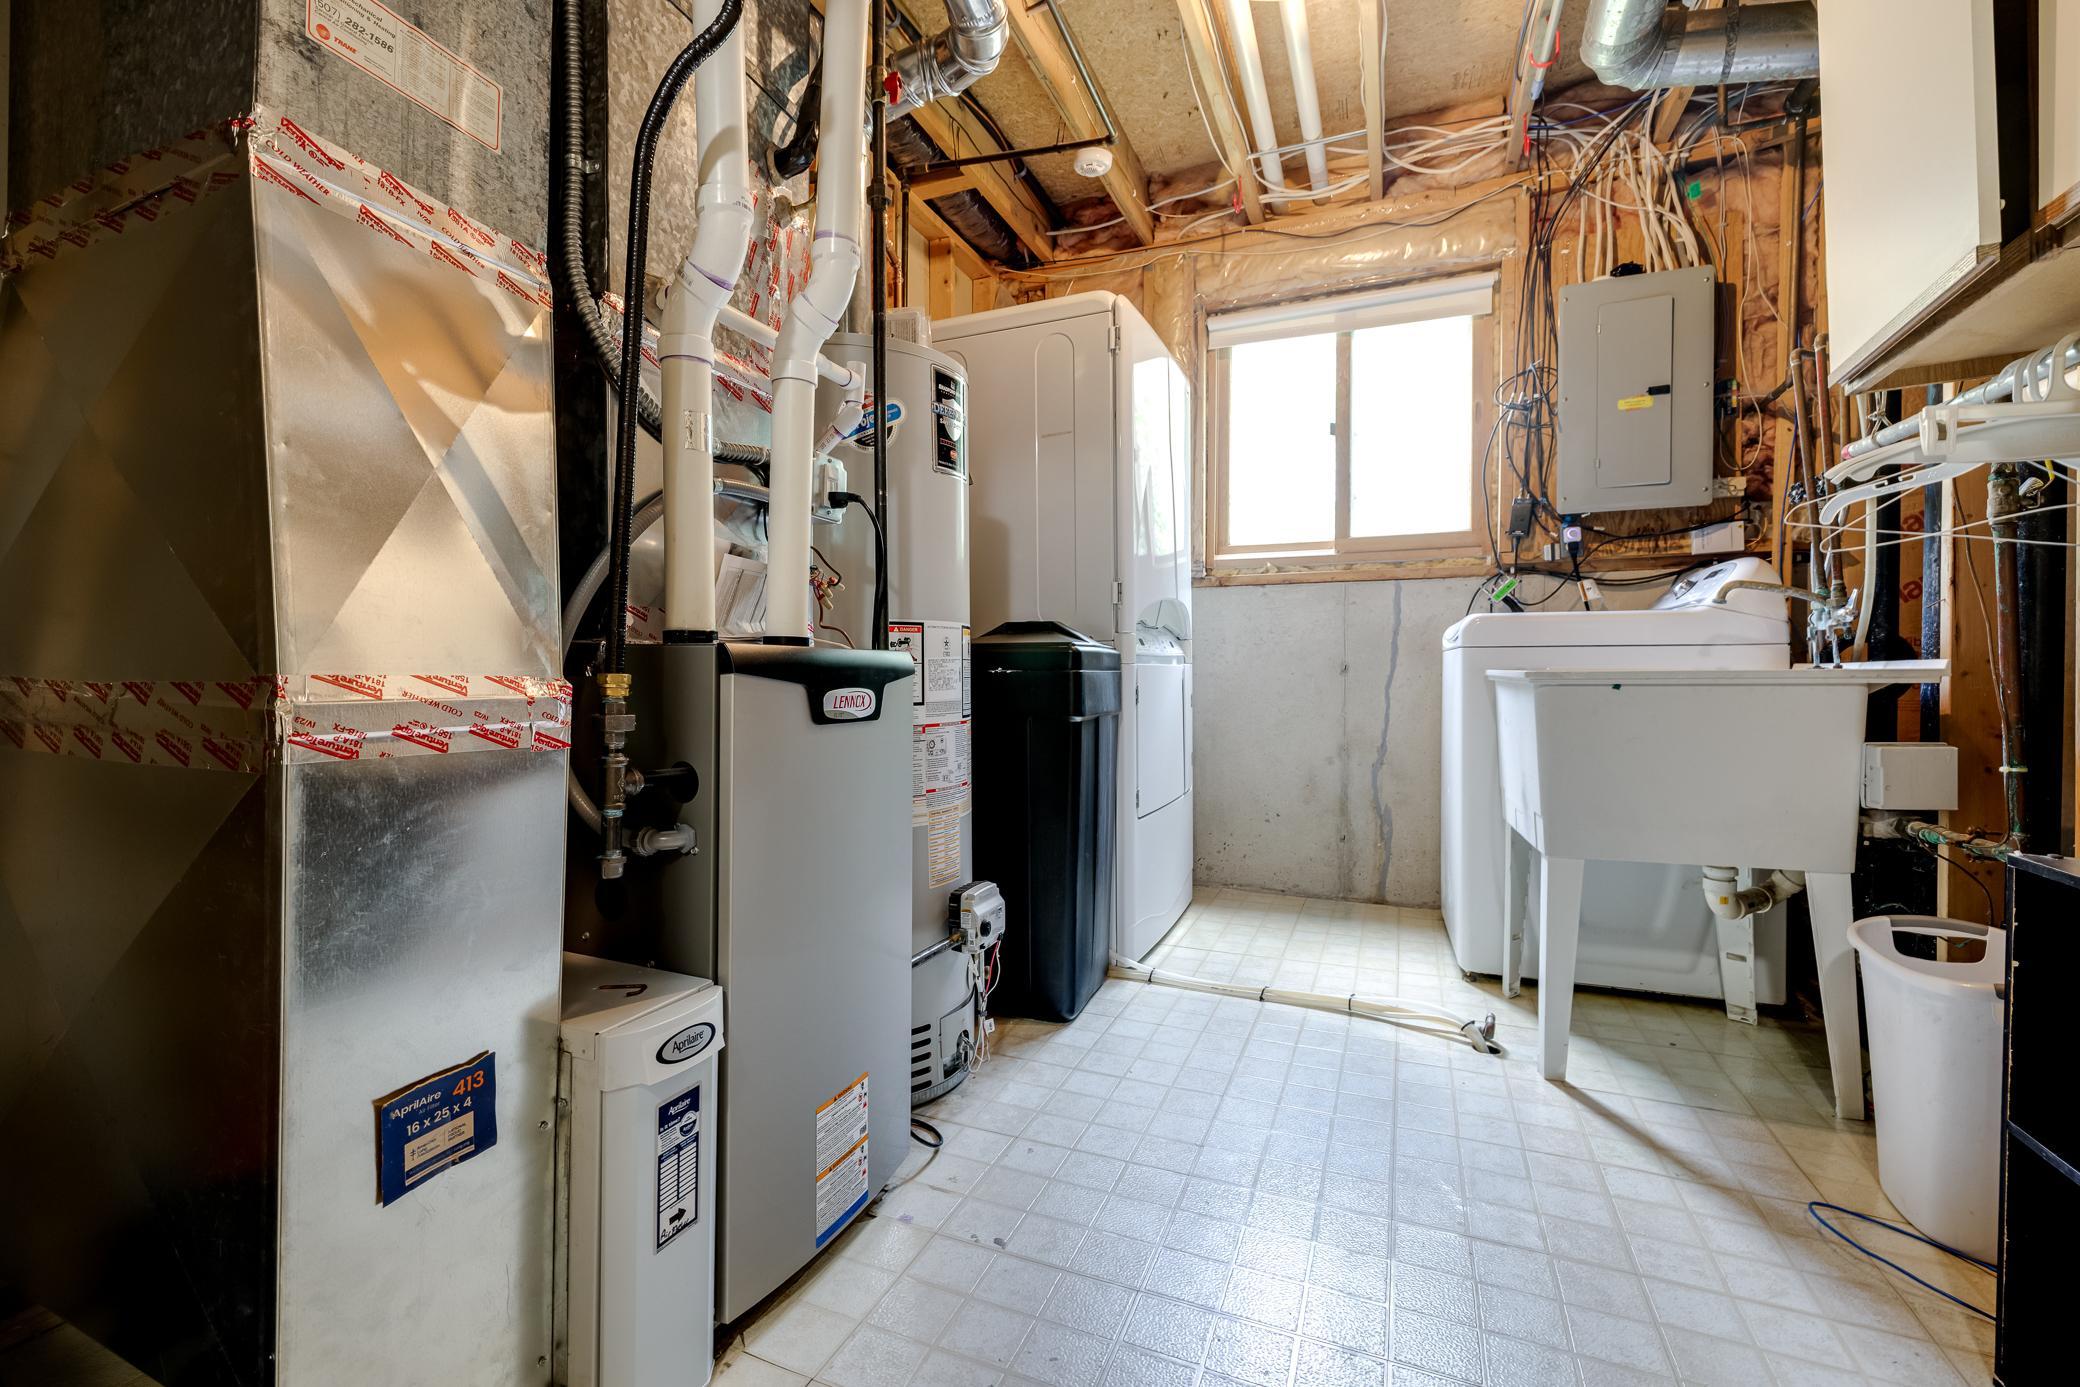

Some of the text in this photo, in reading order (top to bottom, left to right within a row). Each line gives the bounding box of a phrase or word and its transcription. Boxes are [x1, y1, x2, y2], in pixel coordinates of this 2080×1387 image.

[350, 0, 383, 23] echanical
[344, 17, 394, 54] 282-1586
[373, 20, 396, 39] Heating
[333, 36, 358, 55] TRANE
[265, 139, 292, 163] COLD
[292, 161, 332, 196] WEATHER
[377, 177, 406, 207] 181B-FX
[441, 704, 464, 718] COLD
[833, 694, 867, 709] LENNOX
[294, 716, 317, 729] IV/23
[332, 722, 368, 740] 181B-FX
[429, 724, 455, 740] 1581A
[287, 729, 360, 761] VentureTape
[332, 735, 364, 750] 181A-P
[391, 723, 449, 754] VentureTape
[469, 722, 520, 749] VentureTape
[671, 1029, 705, 1053] Aprilaire
[452, 1069, 485, 1097] 413
[392, 1089, 442, 1120] AprilAire
[405, 1095, 473, 1137] 16 x 25 x 4
[668, 1098, 691, 1116] Aprilaire
